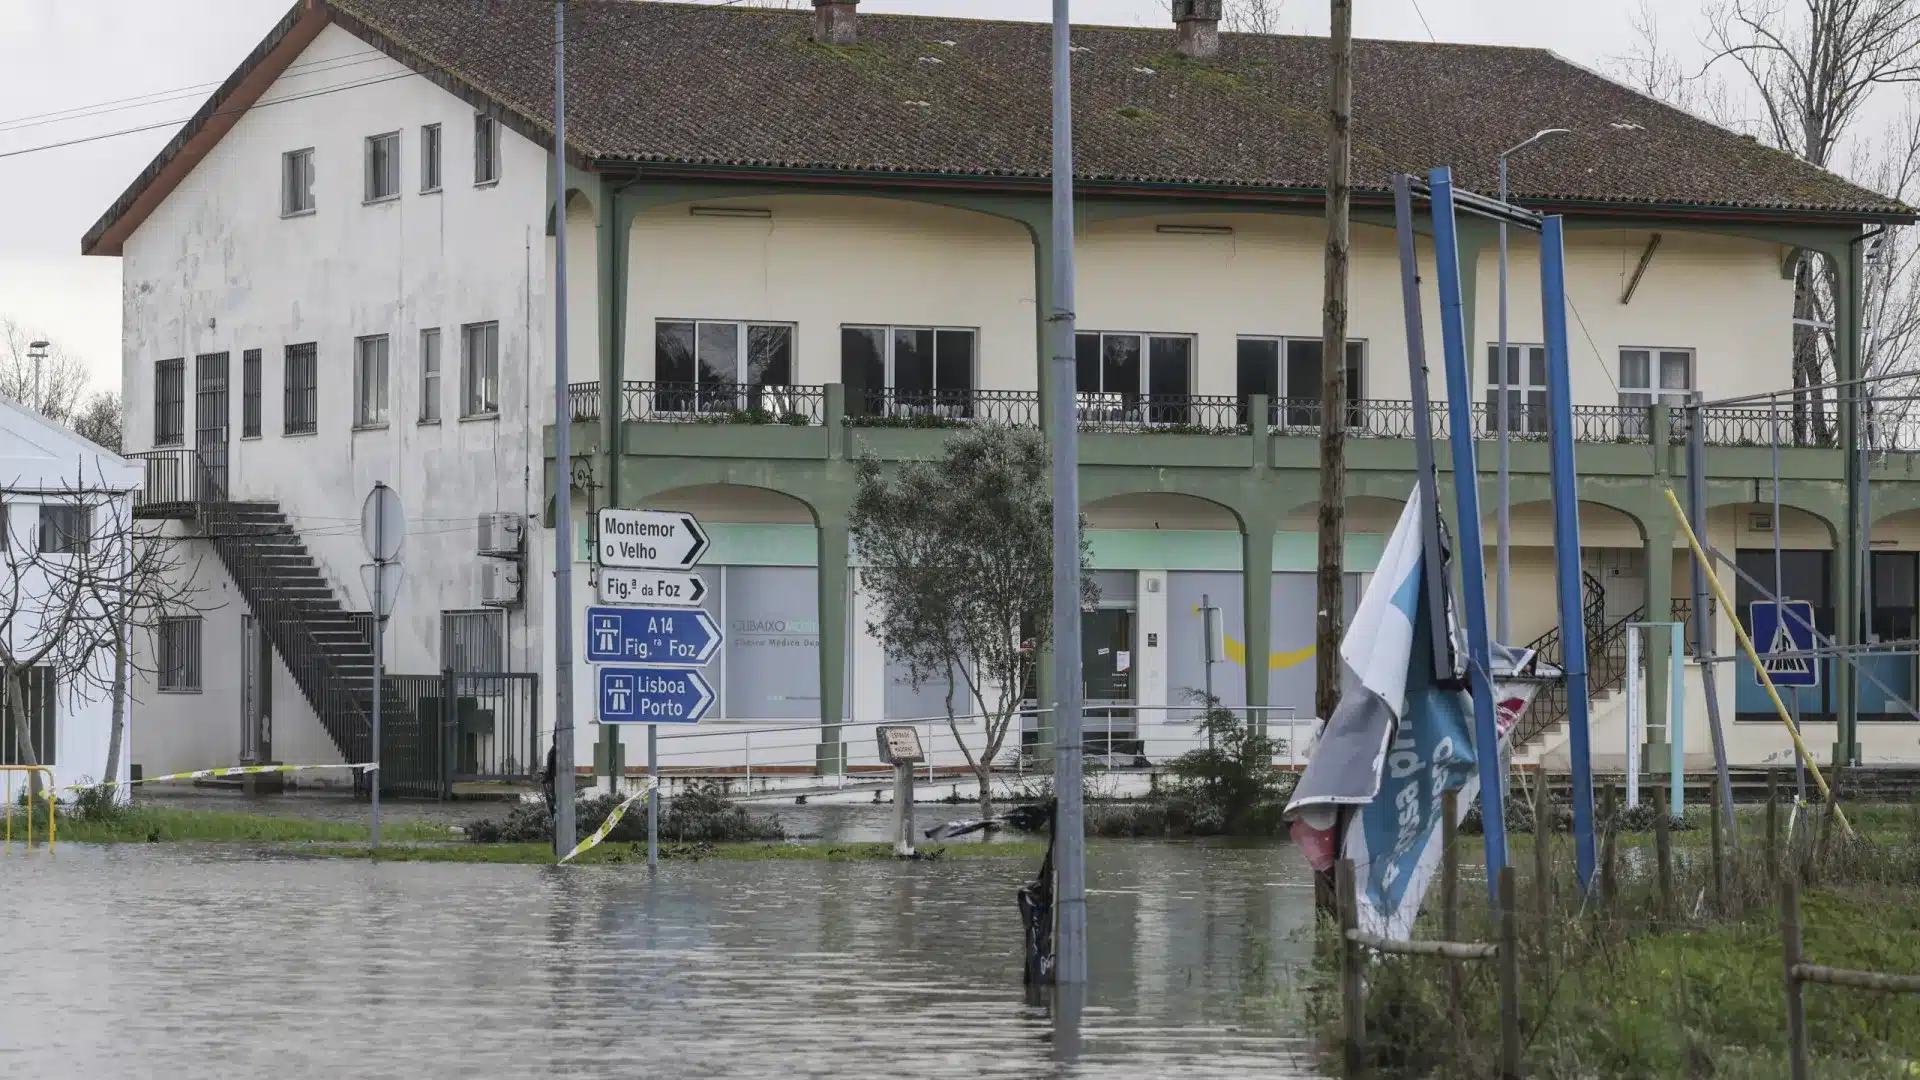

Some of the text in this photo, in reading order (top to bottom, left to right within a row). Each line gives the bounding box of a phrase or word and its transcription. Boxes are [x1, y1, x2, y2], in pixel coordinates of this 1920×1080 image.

[605, 517, 675, 537] Montemor
[606, 541, 657, 560] o Velho
[641, 584, 653, 596] da
[657, 580, 680, 597] Foz
[669, 639, 696, 657] Foz
[637, 676, 686, 694] Lisboa
[641, 698, 683, 716] Porto
